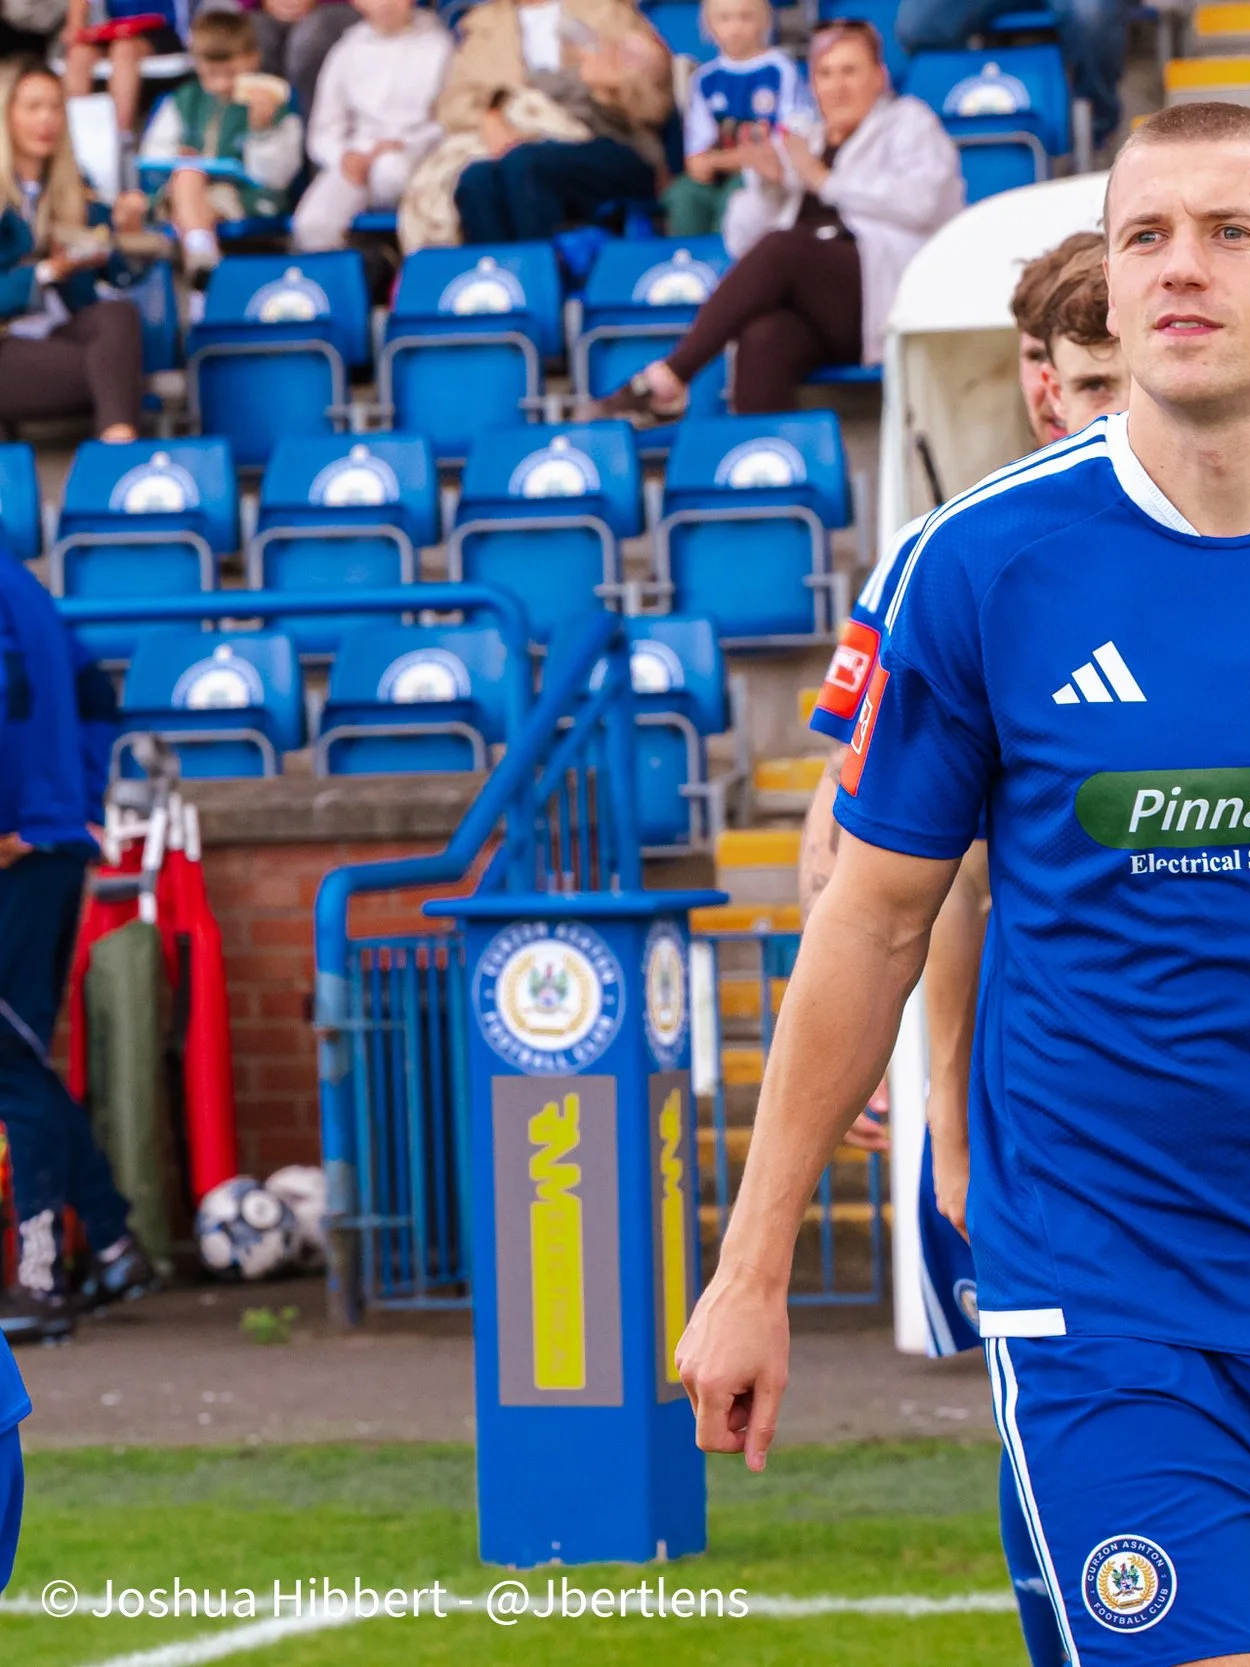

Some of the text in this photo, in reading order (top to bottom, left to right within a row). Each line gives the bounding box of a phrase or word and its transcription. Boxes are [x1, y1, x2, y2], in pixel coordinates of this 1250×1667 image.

[1130, 850, 1242, 874] Electrical
[1087, 1540, 1164, 1581] CURZON ASHTON
[1093, 1587, 1169, 1625] FOOTBALL CLUB
